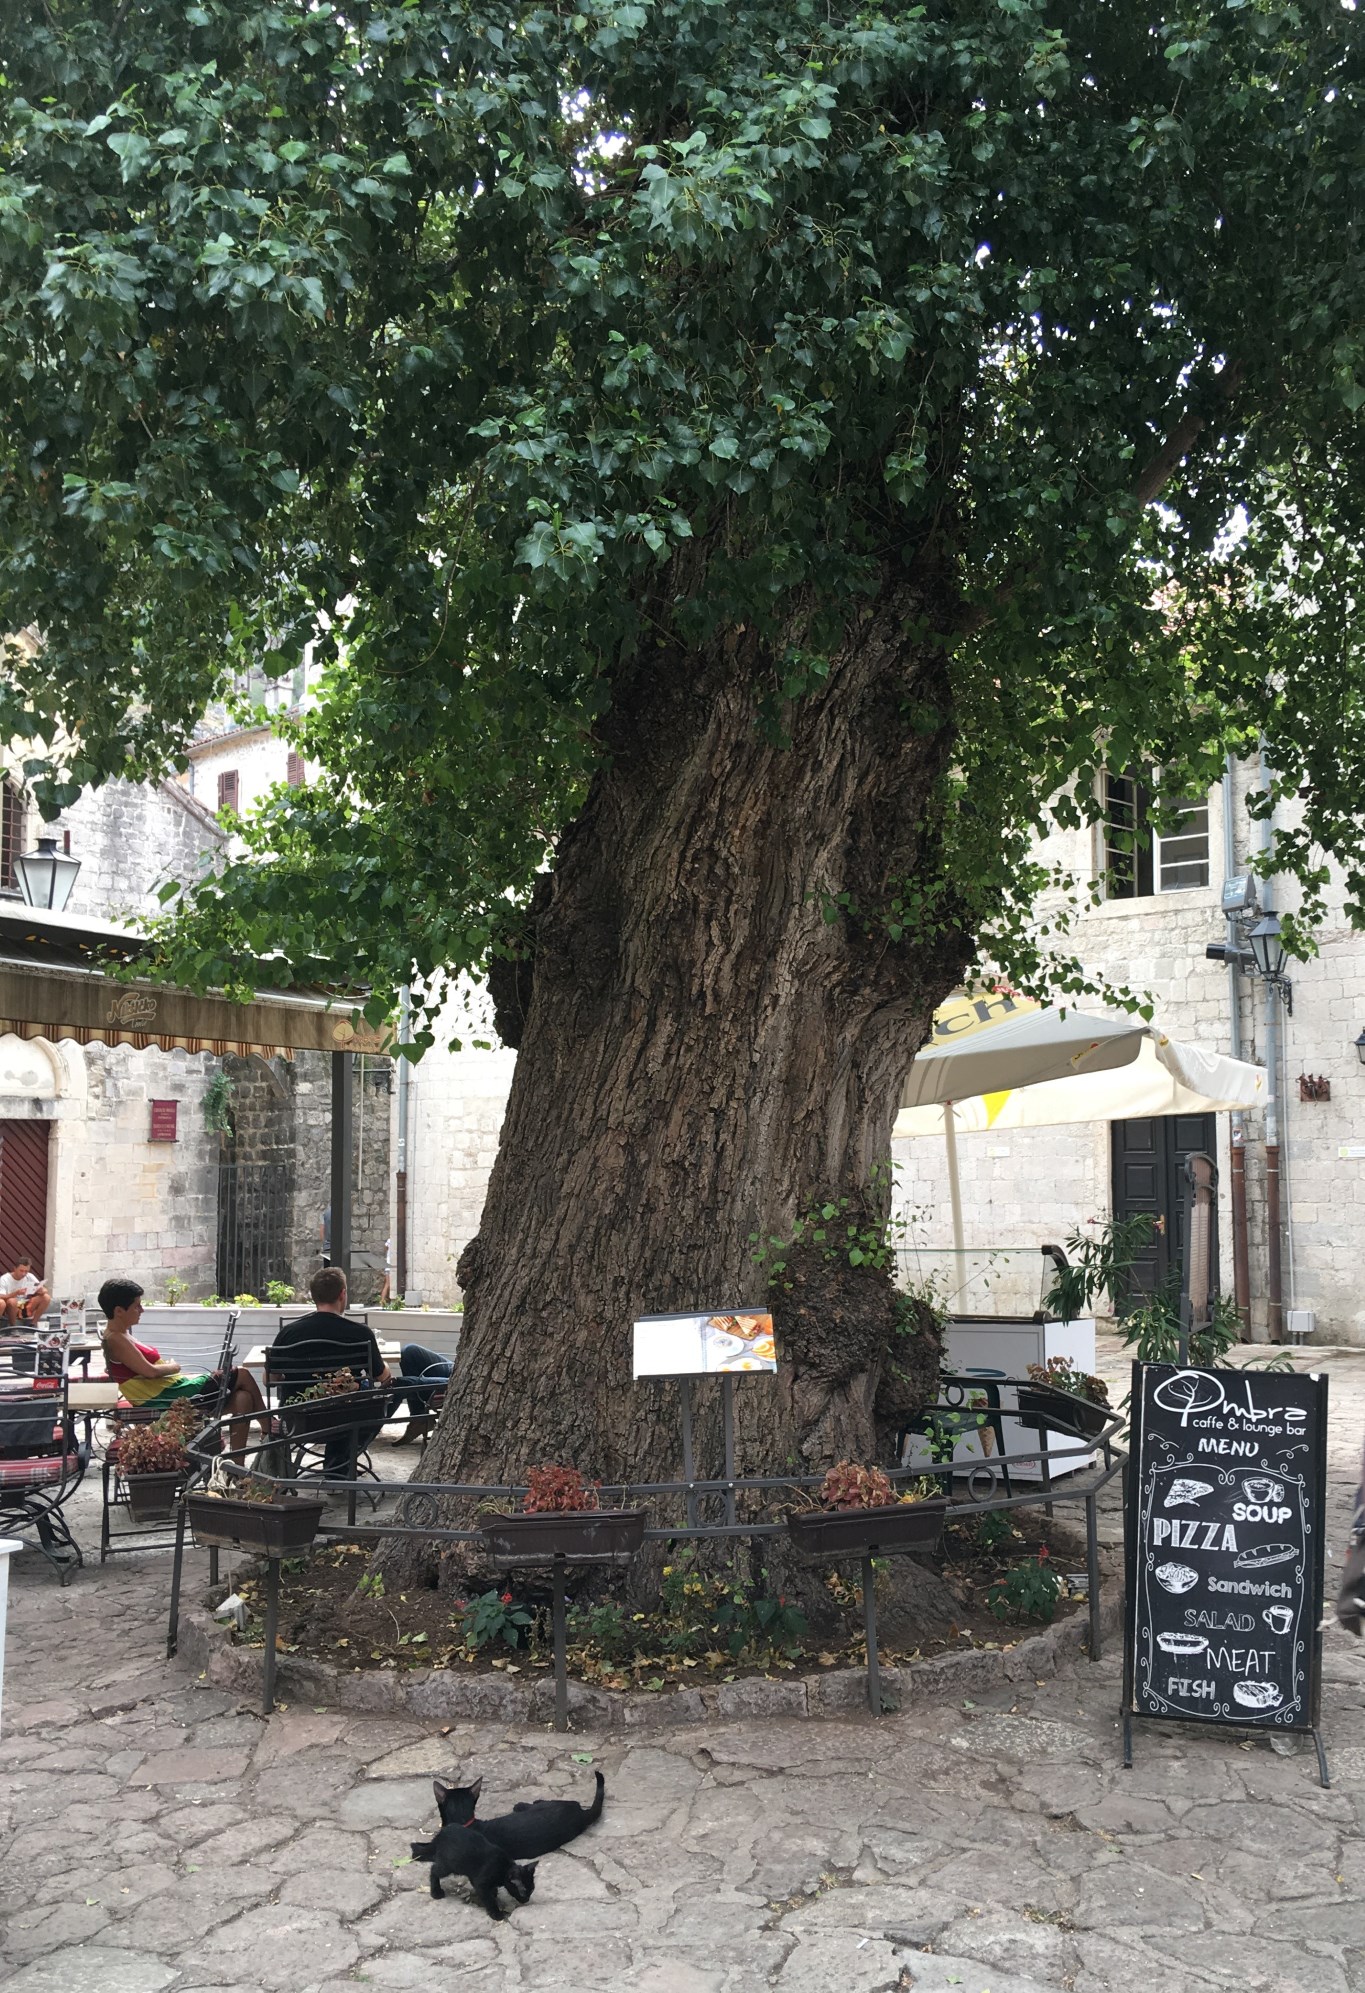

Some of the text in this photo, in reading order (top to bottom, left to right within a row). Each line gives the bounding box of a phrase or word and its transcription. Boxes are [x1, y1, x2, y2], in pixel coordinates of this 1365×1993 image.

[1154, 1370, 1307, 1428] Ombra
[1193, 1415, 1307, 1437] caffe & lounge bar
[1198, 1438, 1259, 1457] MENU
[1231, 1502, 1293, 1524] SOUP
[1152, 1517, 1239, 1552] PIZZA
[1207, 1576, 1293, 1599] Sandwich
[1184, 1609, 1256, 1632] SALAD
[1206, 1647, 1276, 1676] MEAT
[1168, 1676, 1216, 1700] FISH
